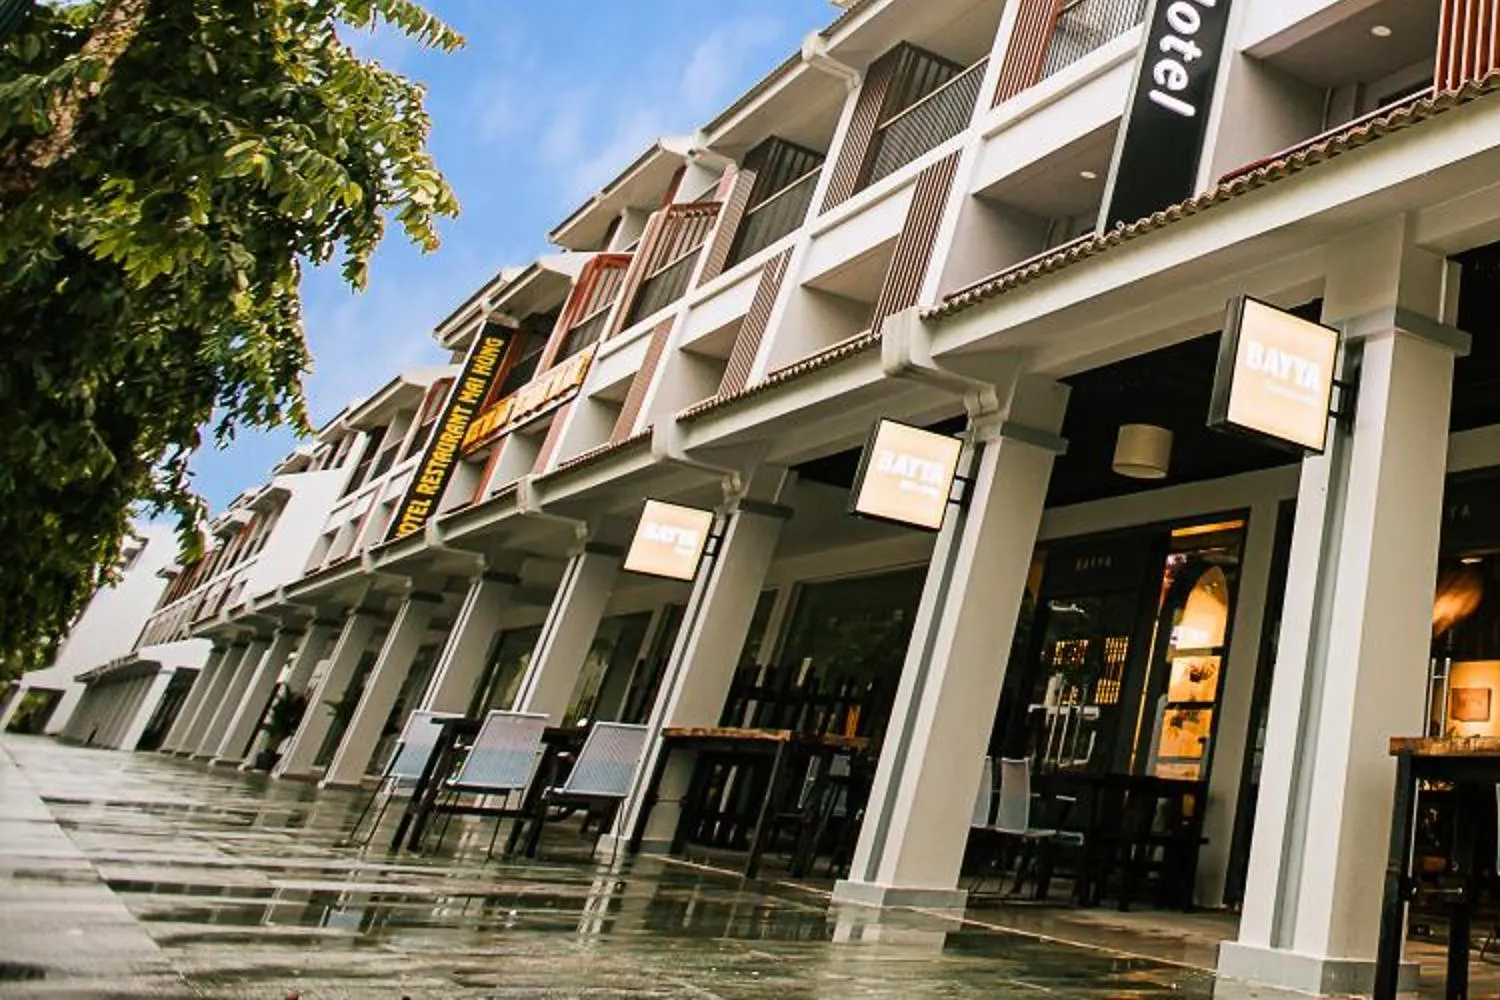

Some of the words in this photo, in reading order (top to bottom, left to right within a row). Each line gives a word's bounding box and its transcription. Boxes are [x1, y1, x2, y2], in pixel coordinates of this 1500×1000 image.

[1246, 341, 1321, 393] BAYYA
[416, 405, 473, 495] RESTAURANT
[457, 376, 485, 404] MAI
